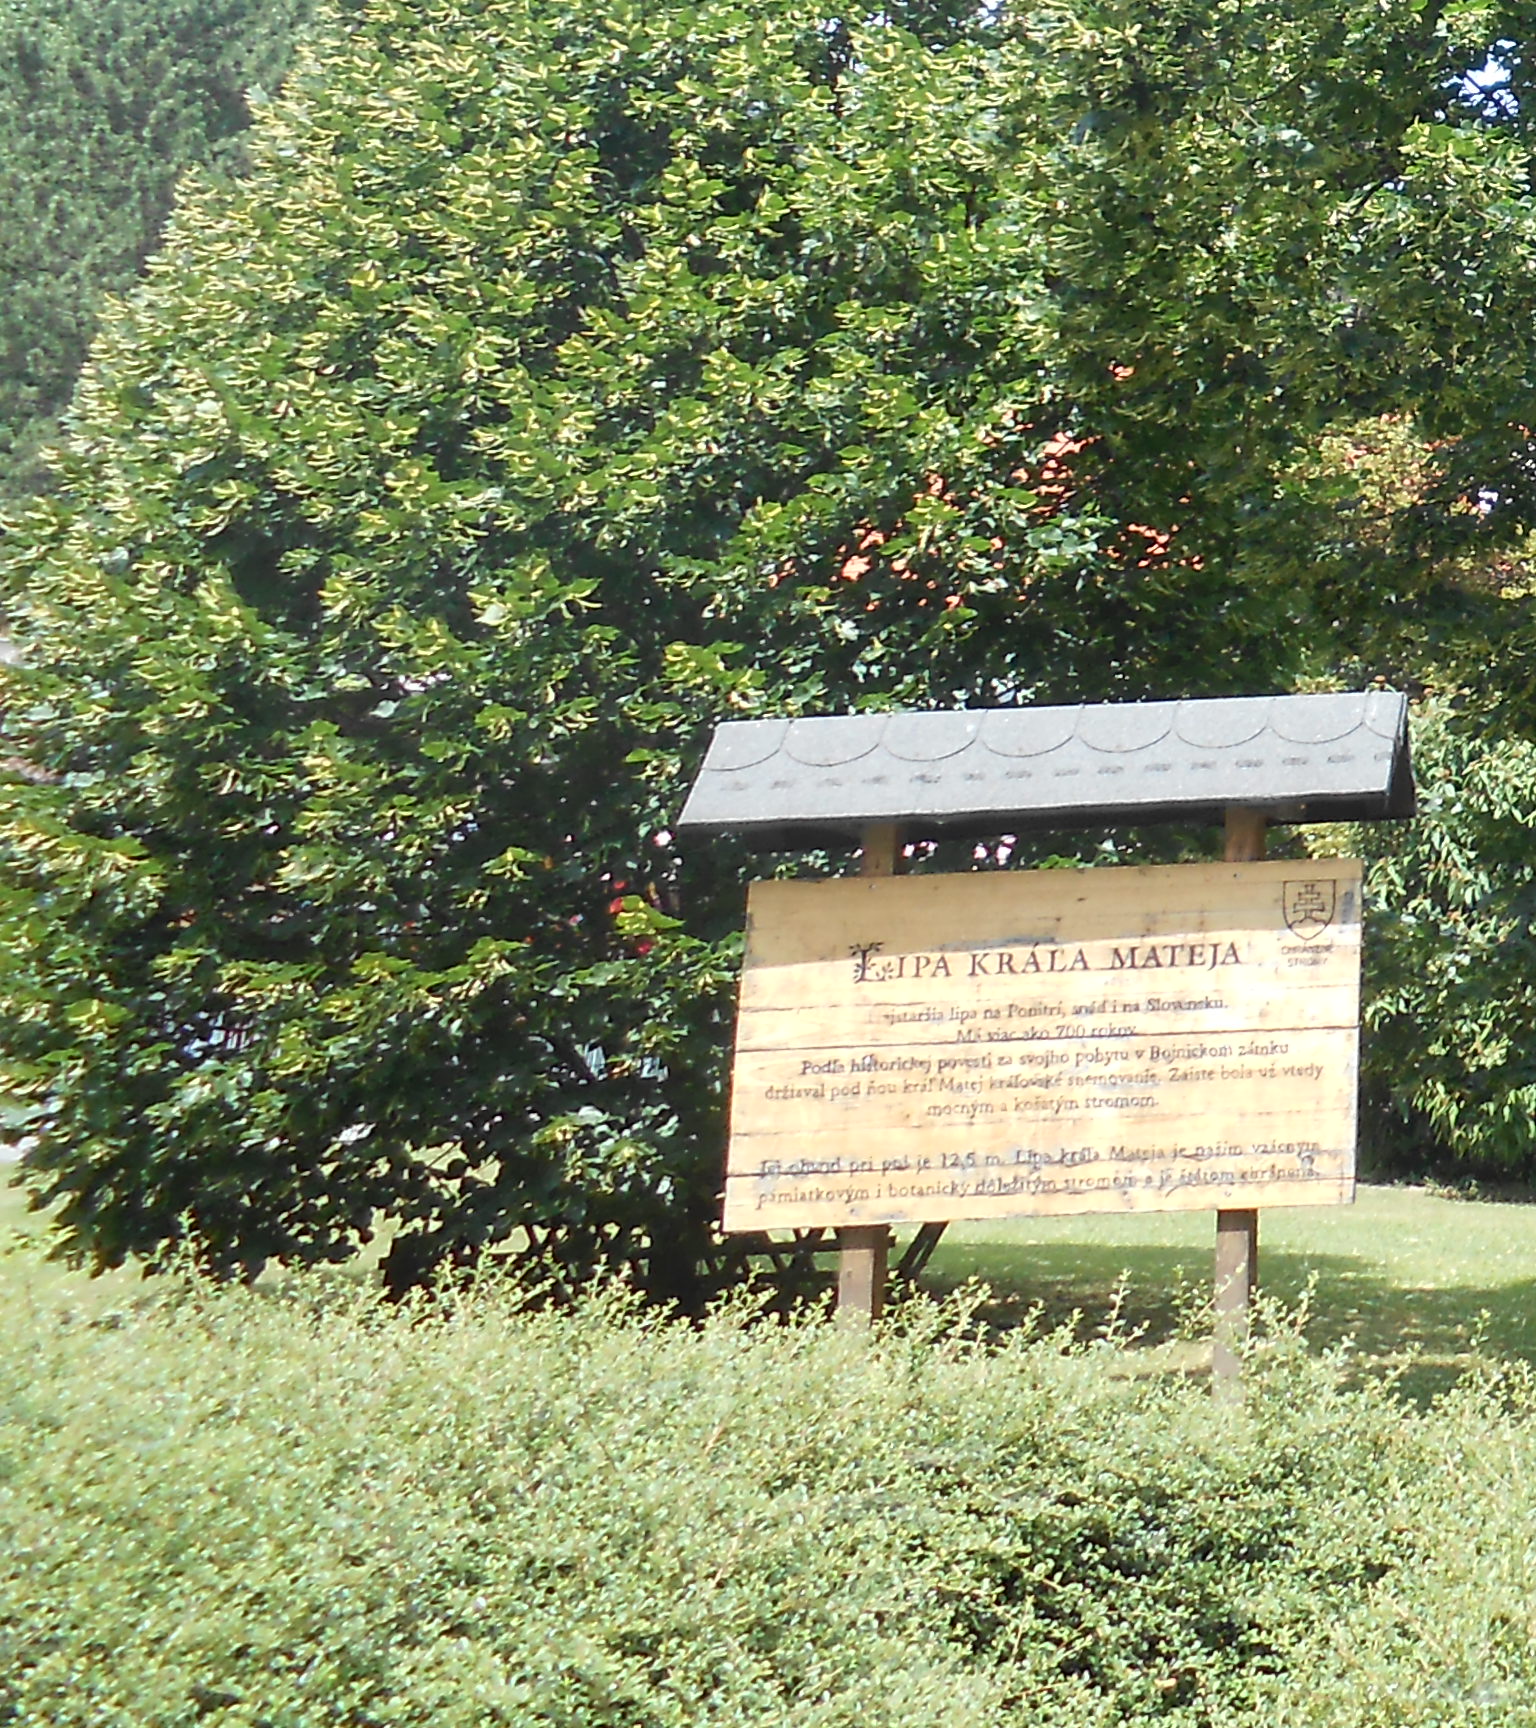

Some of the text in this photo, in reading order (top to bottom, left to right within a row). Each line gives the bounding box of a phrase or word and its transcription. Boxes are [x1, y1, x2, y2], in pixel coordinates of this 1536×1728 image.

[848, 941, 953, 984] LIPA
[1109, 941, 1242, 971] MATEJA
[948, 1006, 978, 1024] lipa
[983, 1007, 1001, 1019] na
[1111, 999, 1118, 1013] i
[1122, 1001, 1140, 1013] na
[987, 1027, 1016, 1041] viac
[1022, 1026, 1049, 1039] ako
[1055, 1024, 1085, 1037] 700
[850, 1056, 931, 1074] historickej
[937, 1053, 992, 1074] povesti
[997, 1056, 1013, 1066] za
[1019, 1050, 1070, 1069] svojho
[1075, 1047, 1129, 1067] pobytu
[1135, 1049, 1145, 1059] v
[1150, 1043, 1232, 1064] Bojnickom
[830, 1081, 861, 1101] pod
[938, 1075, 983, 1094] Matej
[1168, 1066, 1215, 1082] Zaiste
[1221, 1064, 1253, 1080] bola
[1282, 1063, 1324, 1080] vtedy
[1000, 1103, 1007, 1112] a
[849, 1156, 873, 1177] pri
[917, 1155, 931, 1174] je
[1015, 1149, 1052, 1172] Lipa
[1109, 1144, 1165, 1161] Mateja
[1173, 1144, 1187, 1162] je
[755, 1183, 870, 1210] pamiatkovým
[875, 1184, 881, 1198] i
[888, 1180, 970, 1198] botanicky
